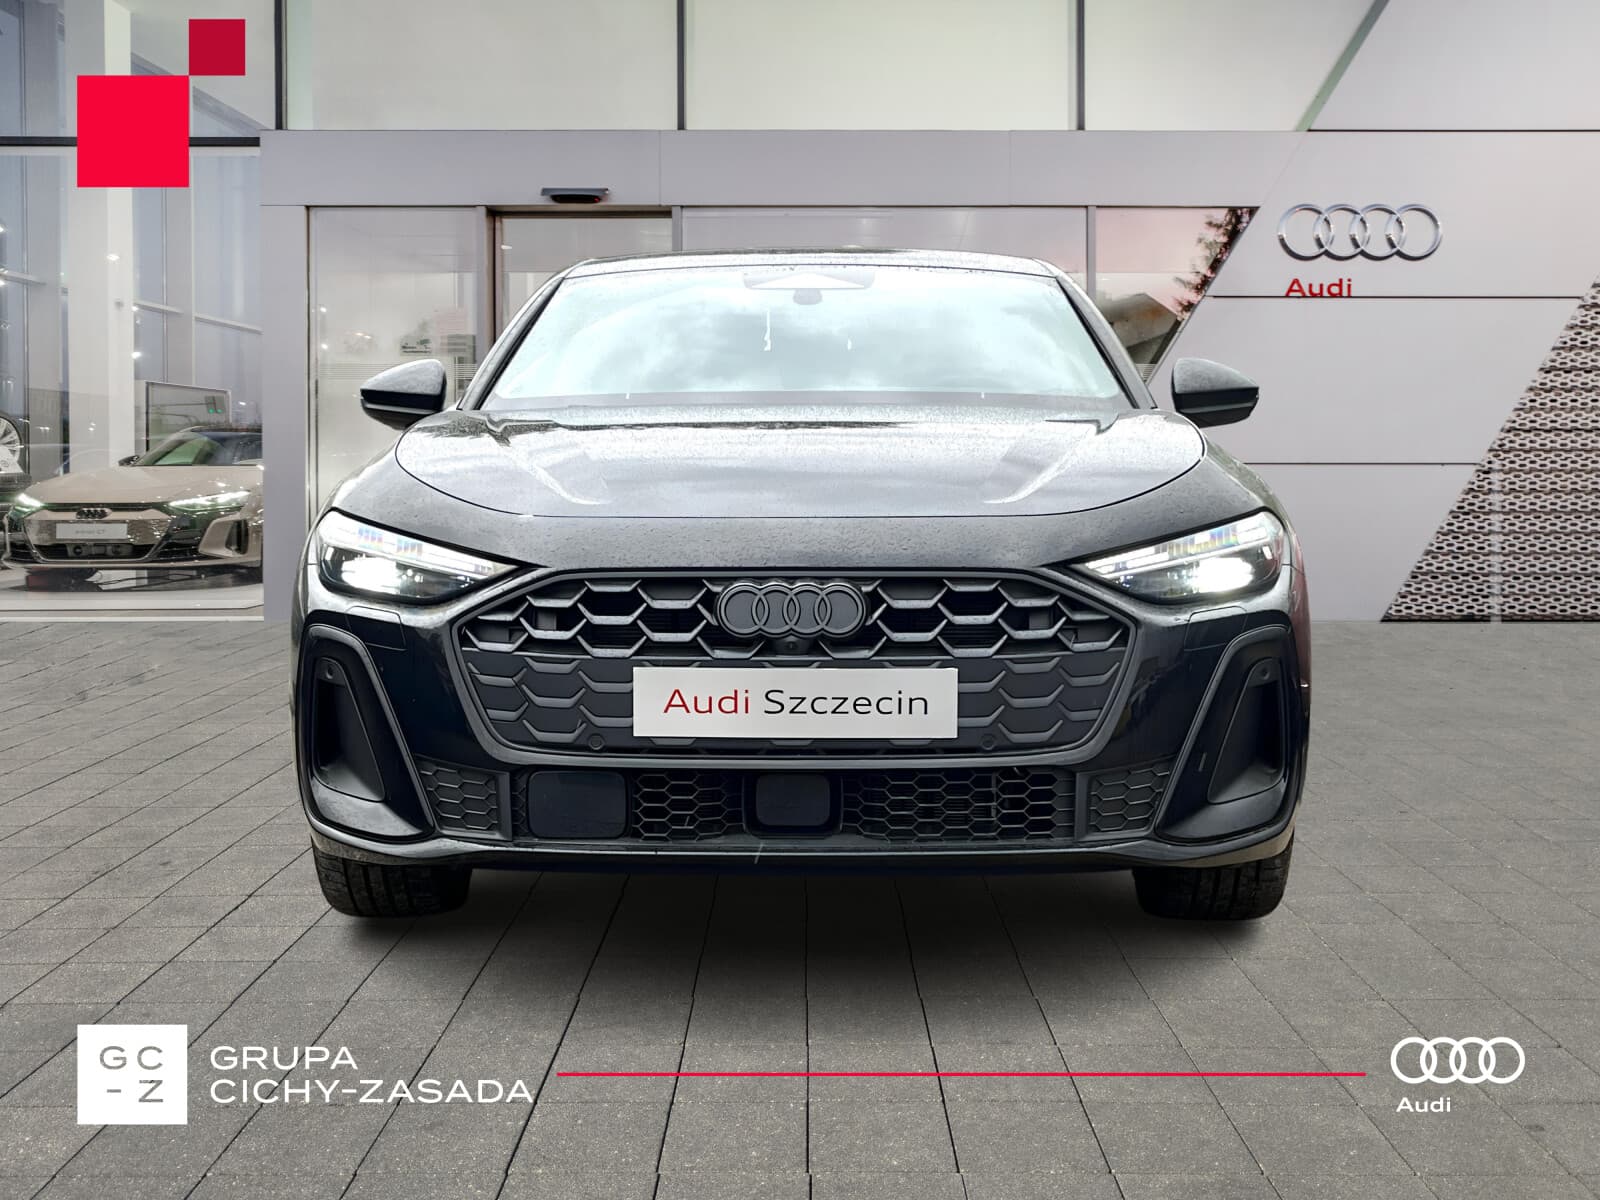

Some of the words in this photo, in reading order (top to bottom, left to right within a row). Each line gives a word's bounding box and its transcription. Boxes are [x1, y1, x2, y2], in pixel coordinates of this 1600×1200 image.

[1285, 277, 1352, 297] Audi
[664, 688, 749, 714] Audi
[763, 689, 928, 715] Szczecin
